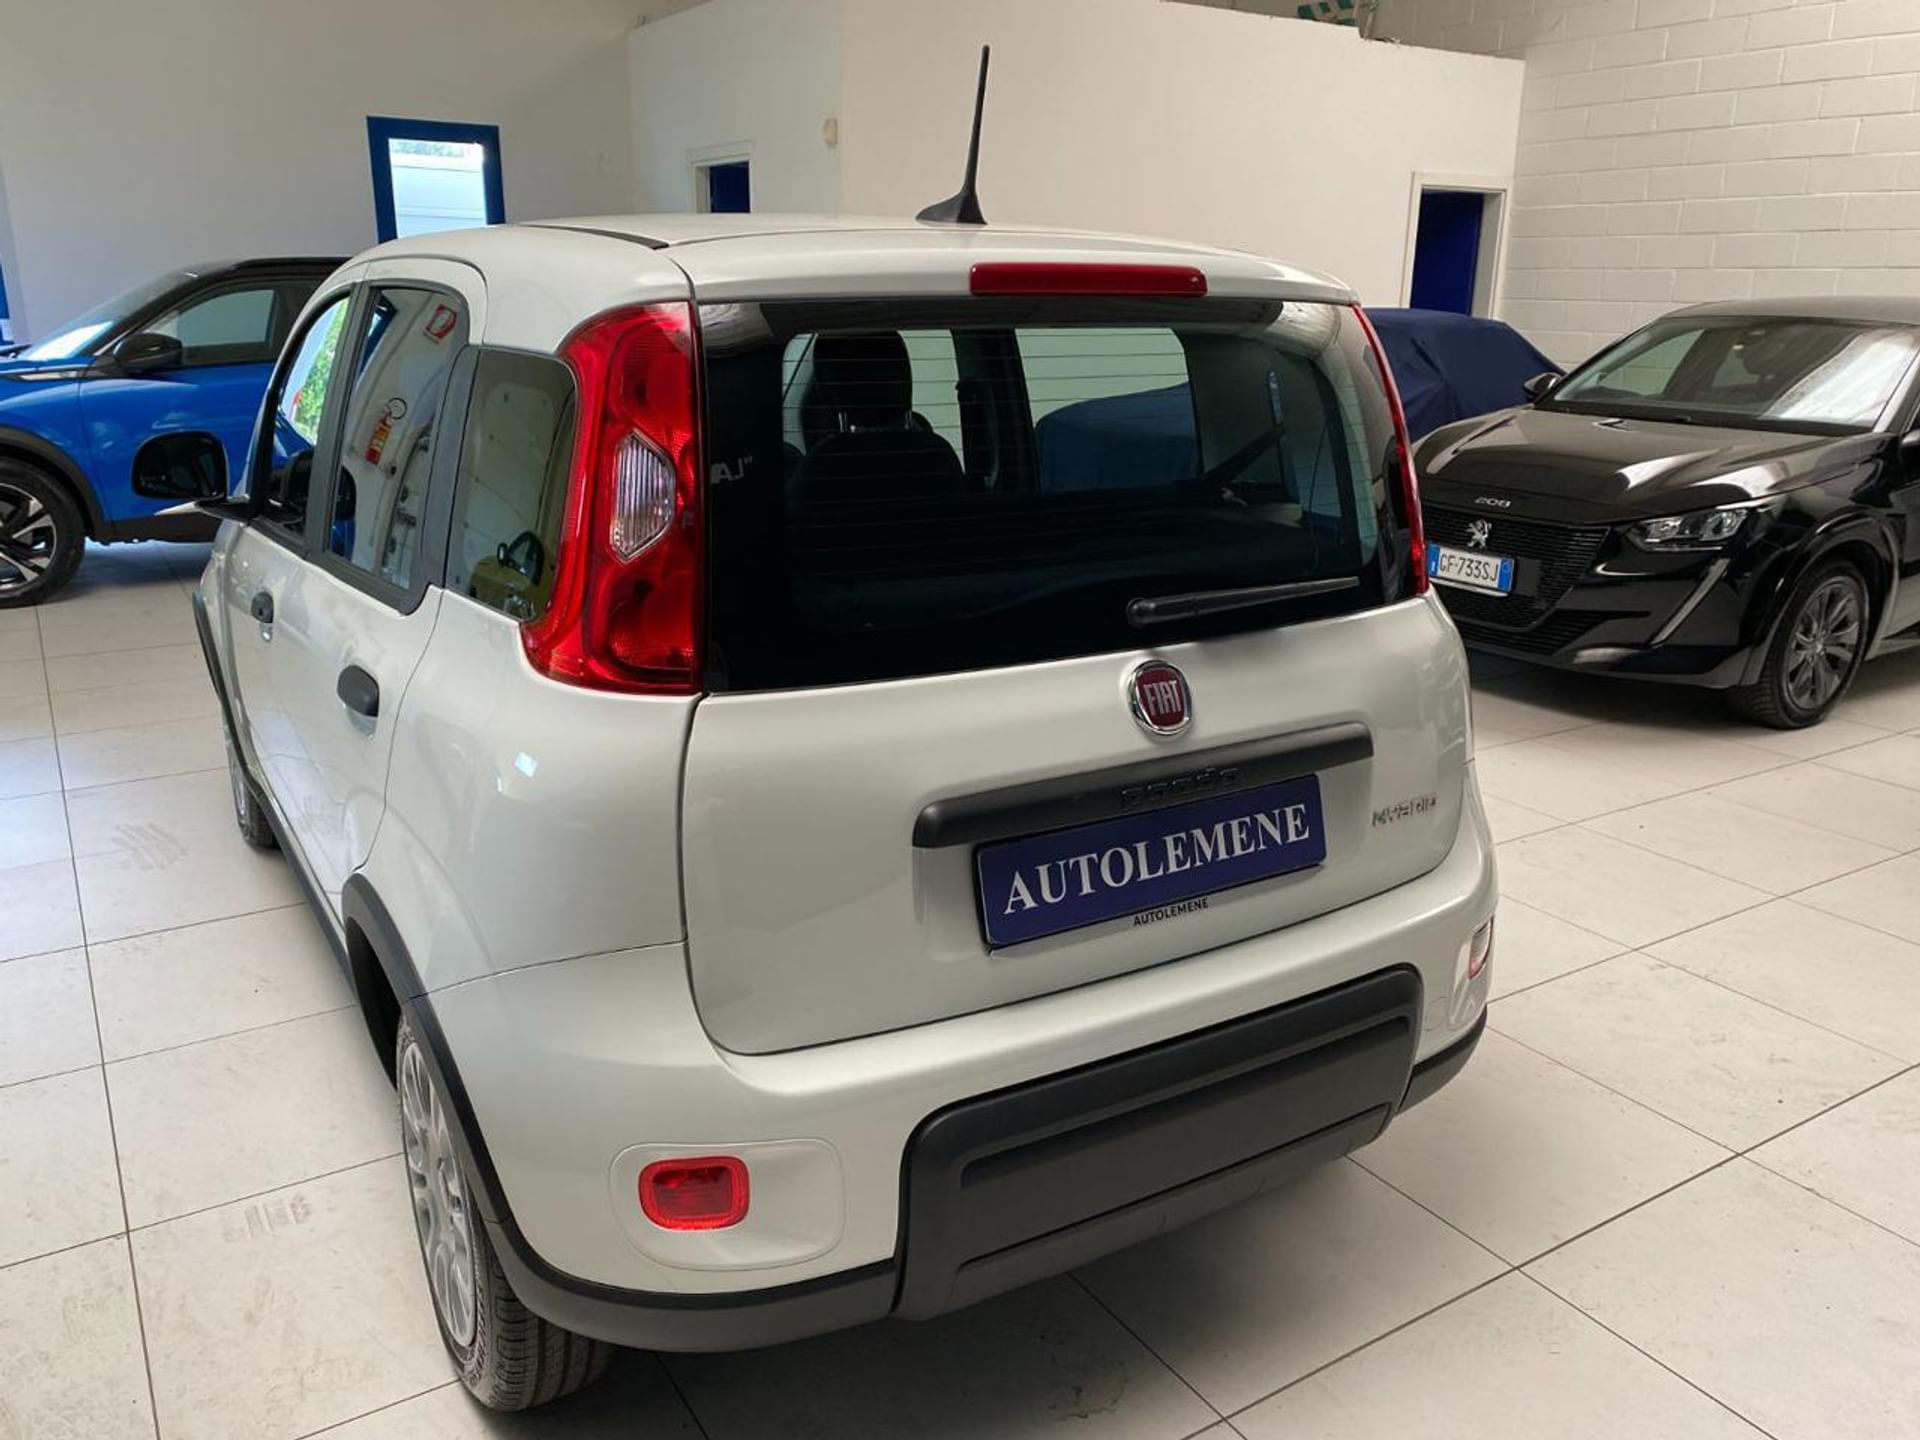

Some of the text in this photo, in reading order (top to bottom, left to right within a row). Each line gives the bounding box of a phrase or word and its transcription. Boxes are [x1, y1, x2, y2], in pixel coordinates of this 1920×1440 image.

[1143, 680, 1181, 716] FIAT
[1003, 803, 1309, 915] AUTOLEMENE
[1133, 897, 1209, 927] AUTOLEMENE
